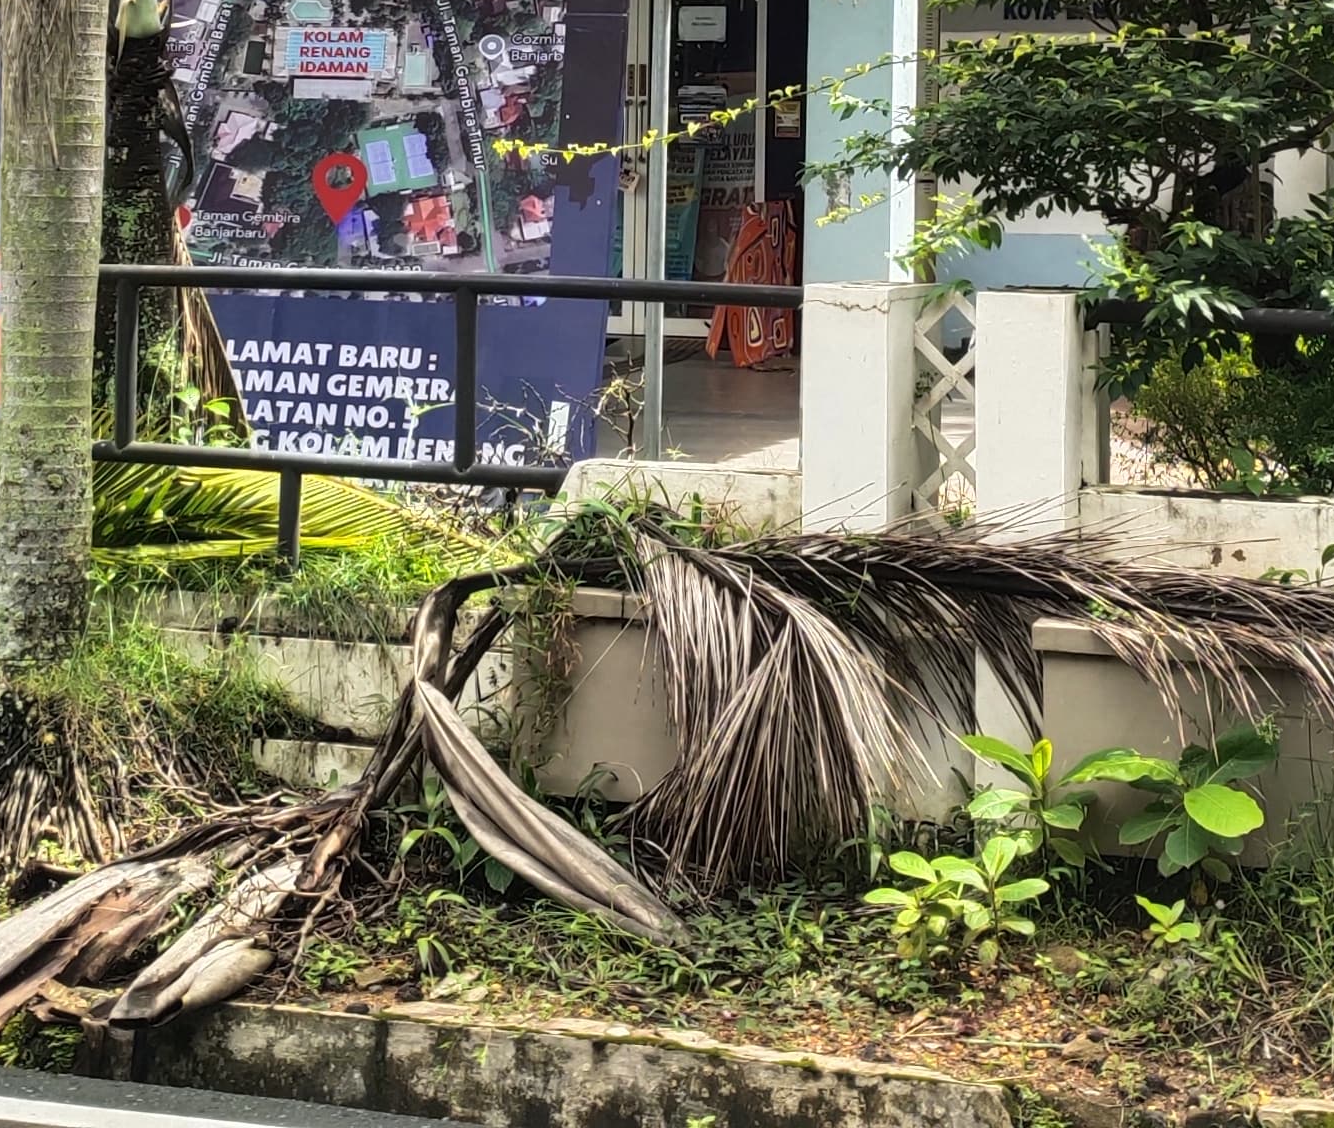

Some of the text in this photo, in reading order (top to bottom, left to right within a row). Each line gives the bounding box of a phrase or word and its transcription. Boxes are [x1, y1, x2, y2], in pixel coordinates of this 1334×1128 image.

[303, 30, 364, 44] KOLAM
[191, 2, 234, 103] Gembira Barat
[299, 45, 371, 60] RENANG
[299, 60, 368, 73] IDAMAN
[444, 17, 465, 66] Taman
[456, 65, 477, 127] Gembira
[467, 128, 486, 171] Timur
[541, 154, 558, 166] Su
[197, 210, 301, 224] Taman Gembira
[194, 225, 267, 240] Banjarbaru
[208, 252, 225, 264] Jl.
[338, 344, 423, 370] BARU
[326, 373, 456, 402] GEMBIR
[343, 403, 396, 430] NO.
[276, 430, 391, 460] KOLAM
